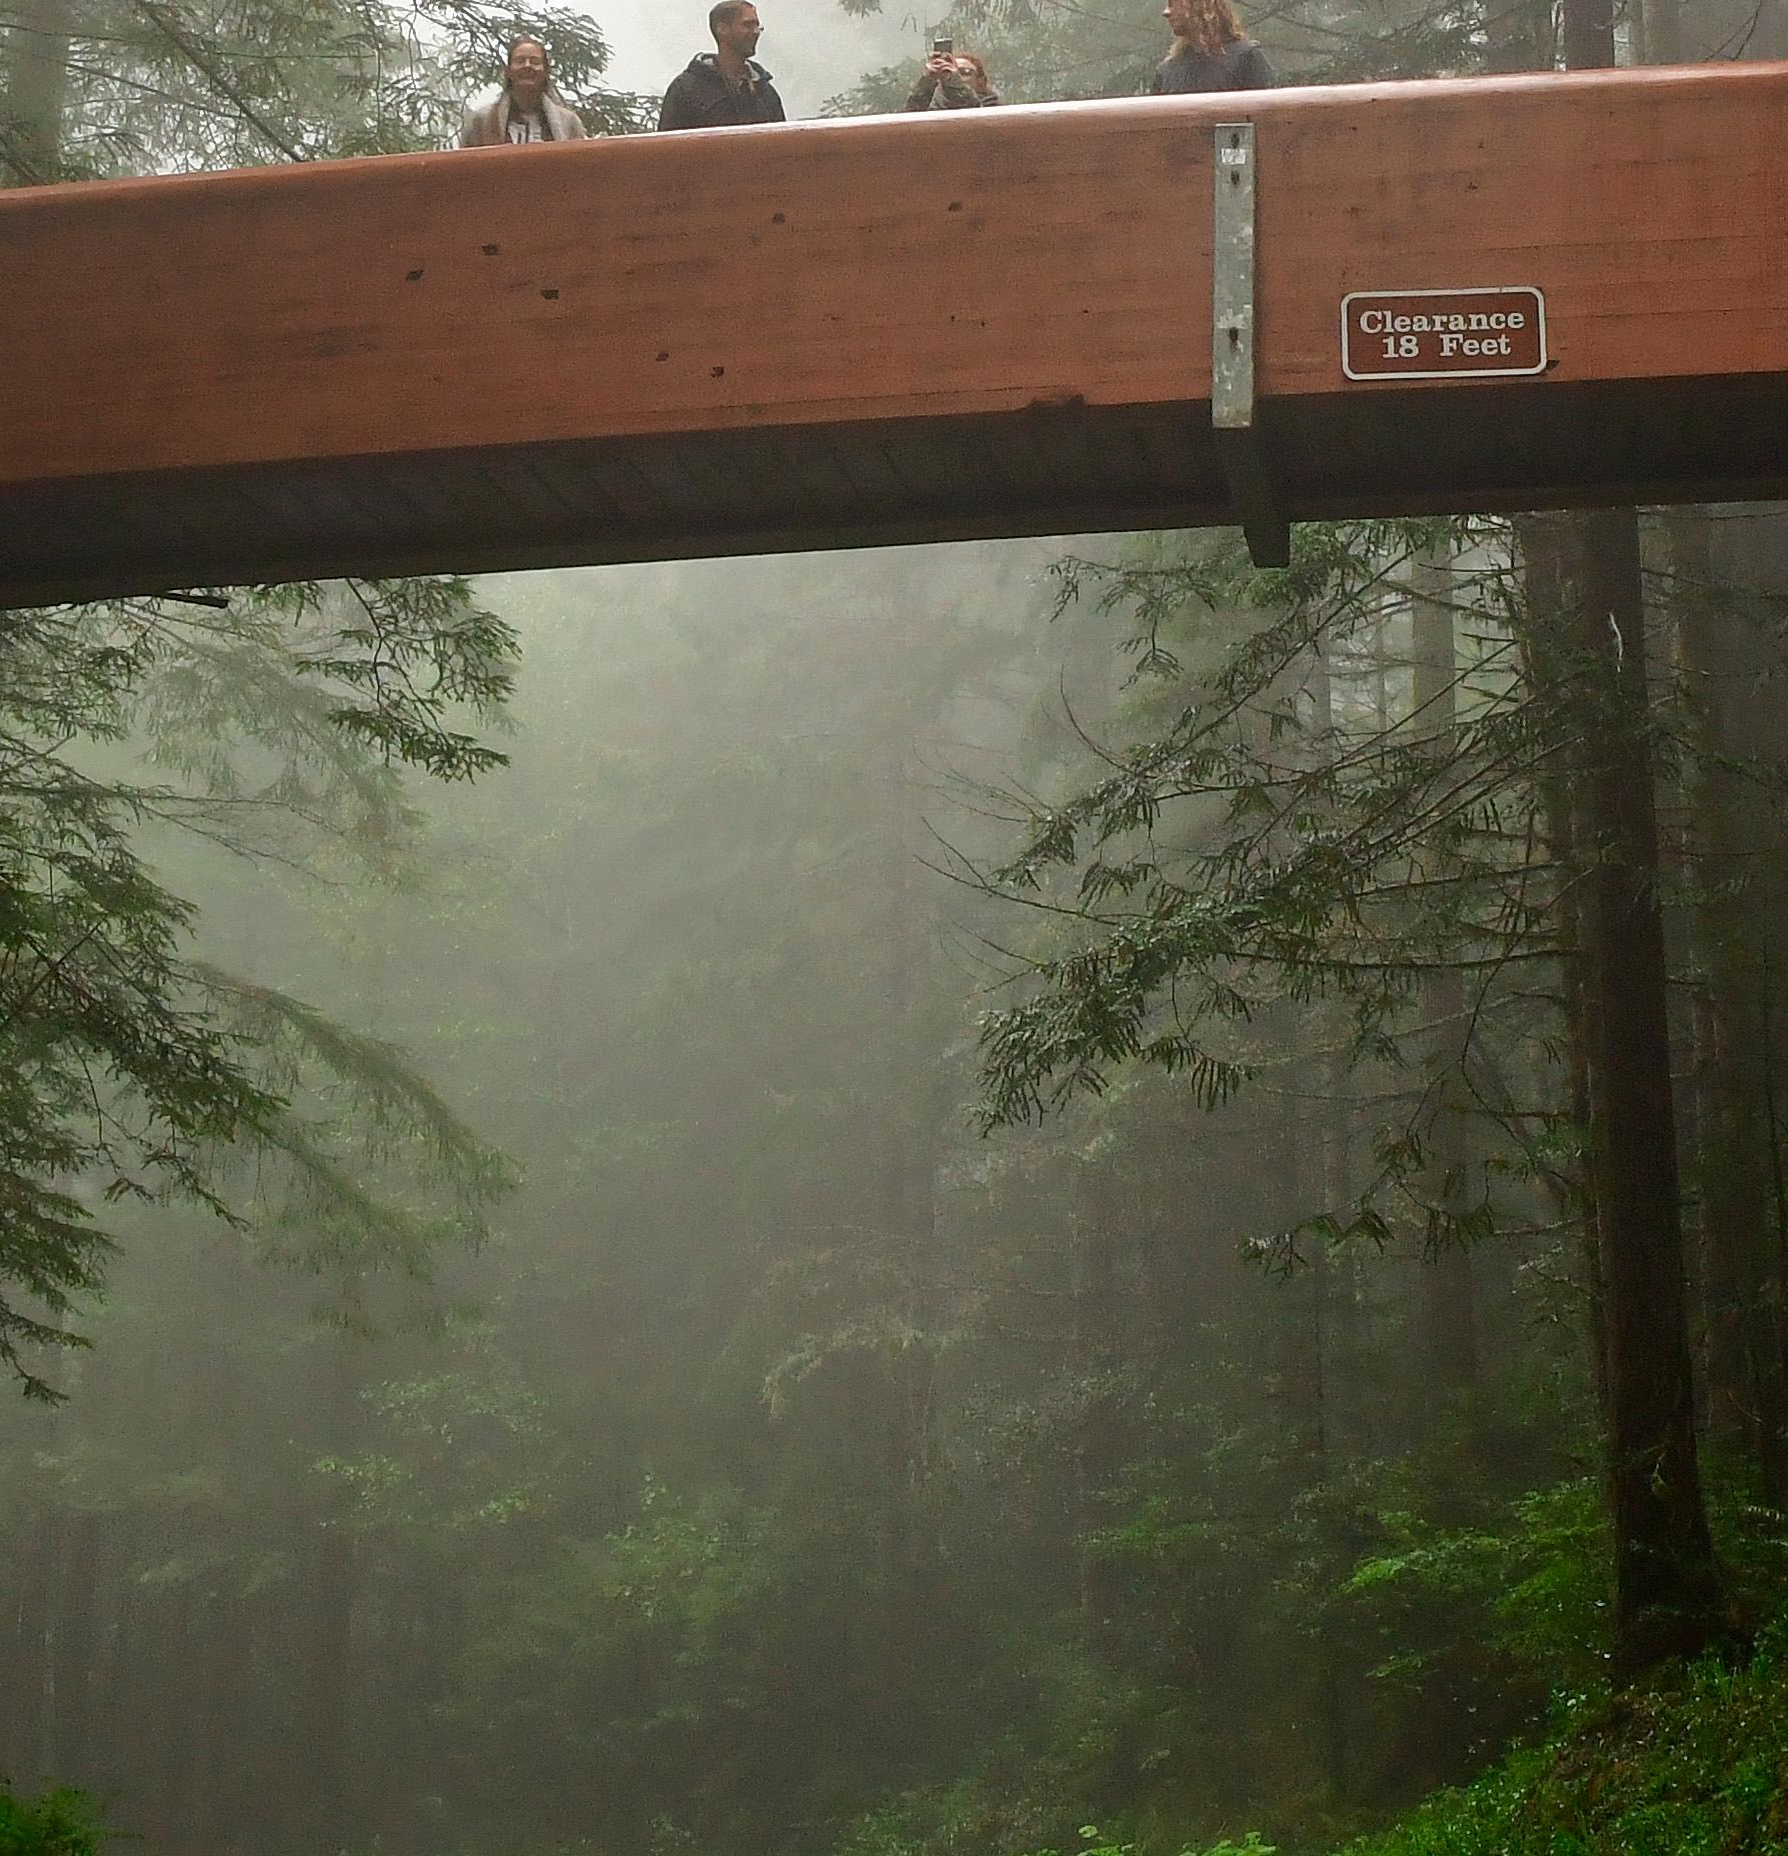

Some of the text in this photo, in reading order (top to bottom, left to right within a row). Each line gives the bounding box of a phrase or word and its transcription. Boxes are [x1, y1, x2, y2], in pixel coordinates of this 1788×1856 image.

[1359, 310, 1525, 333] Clearance
[1382, 334, 1511, 358] 18 Feet
